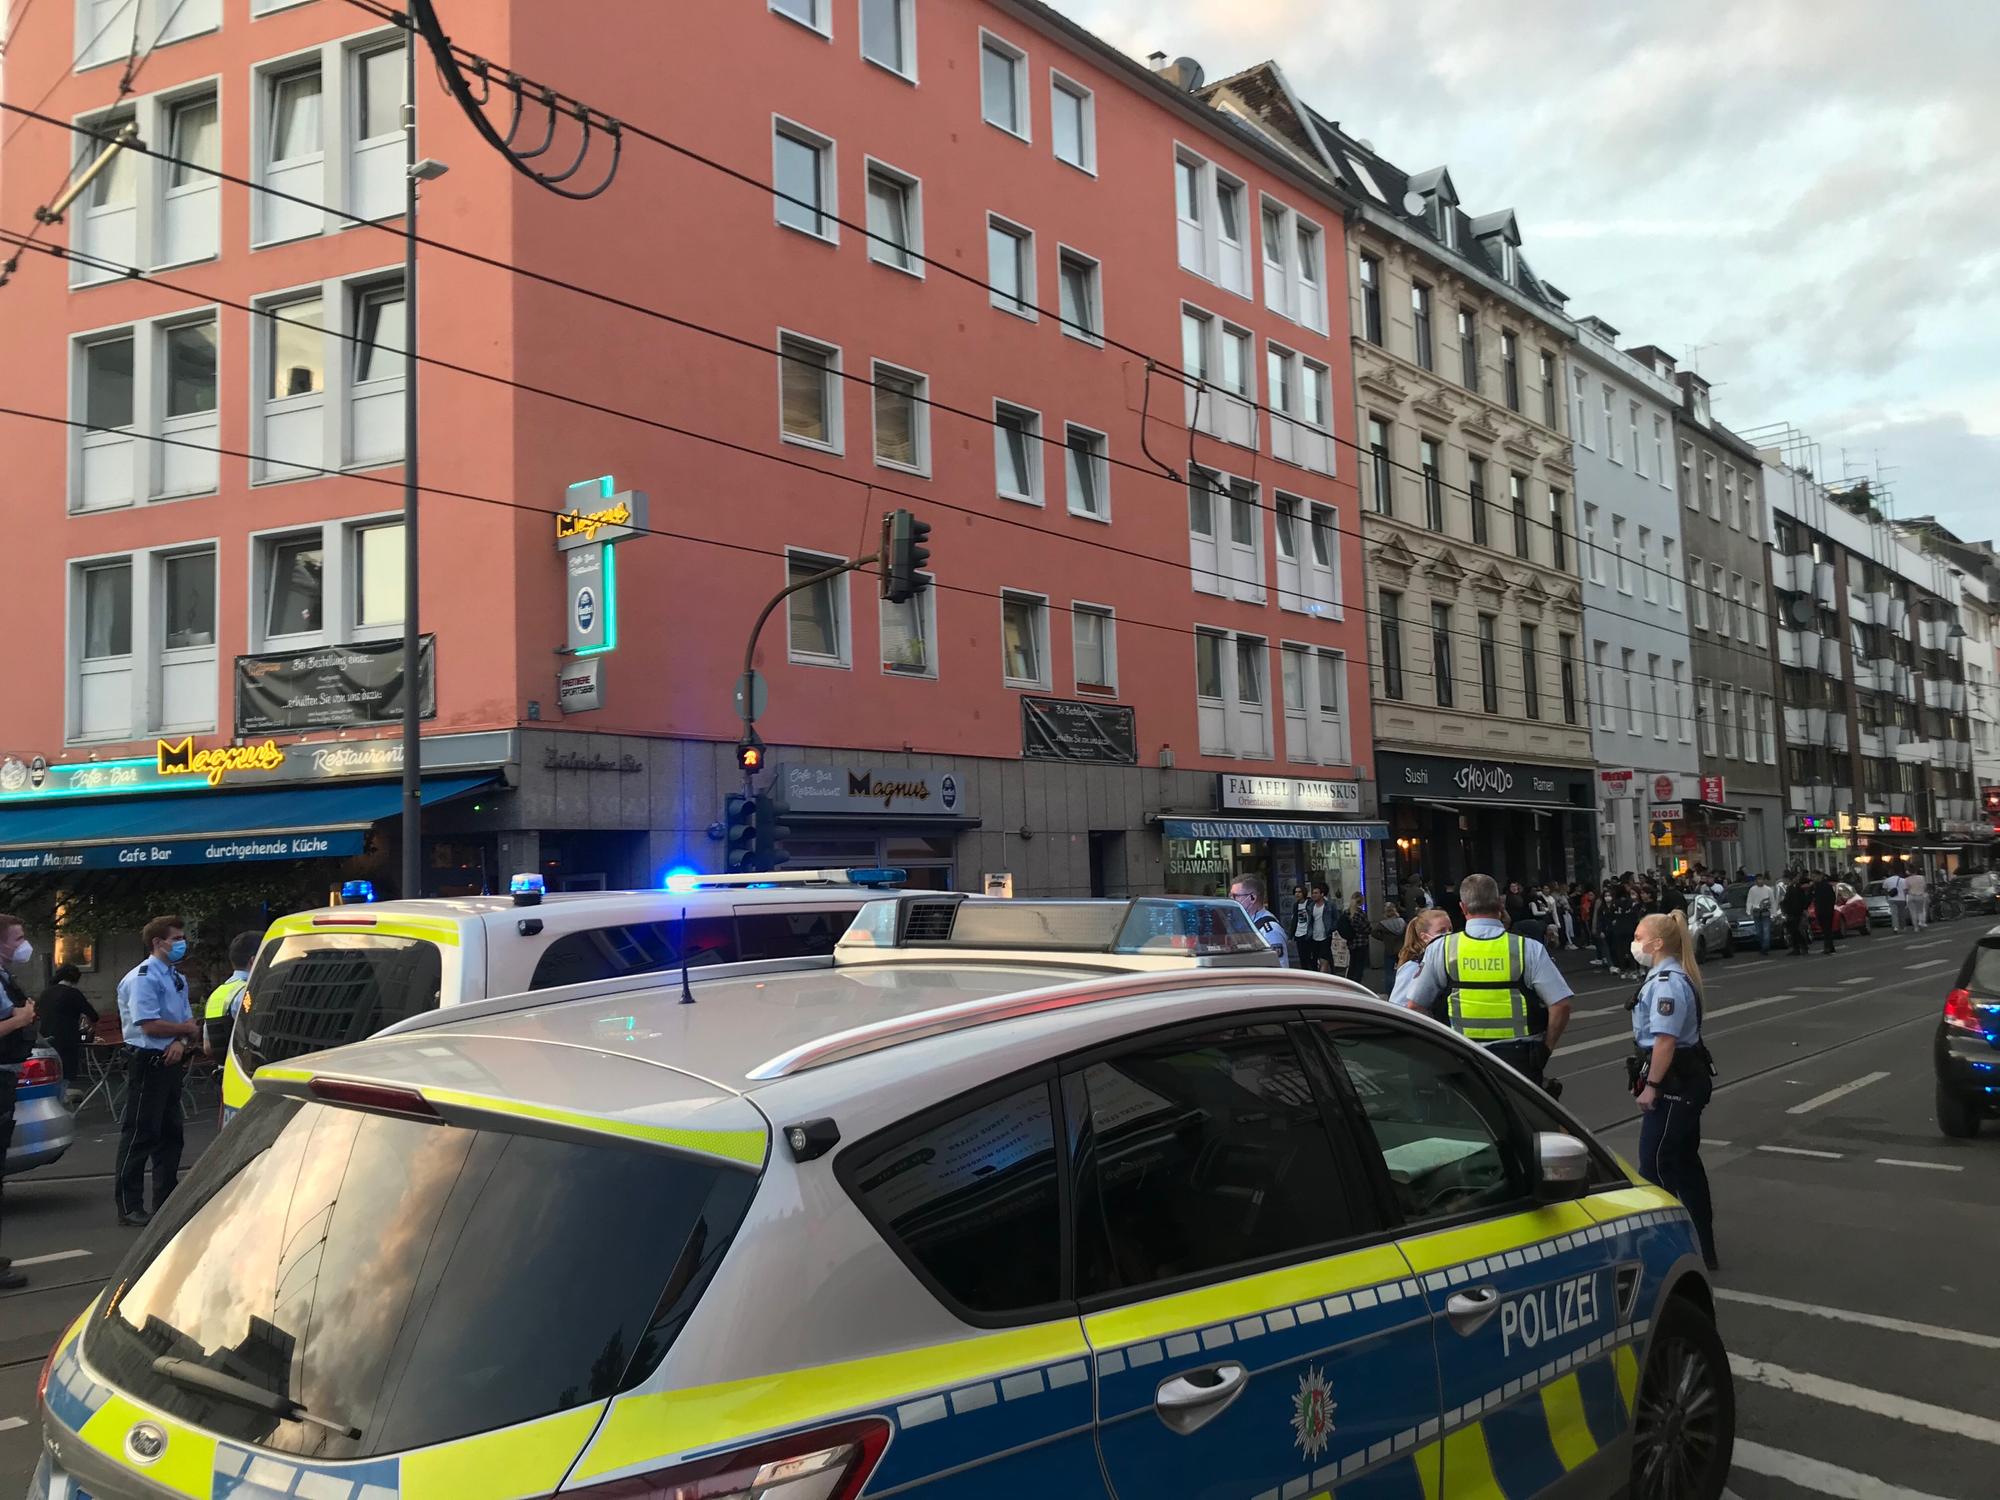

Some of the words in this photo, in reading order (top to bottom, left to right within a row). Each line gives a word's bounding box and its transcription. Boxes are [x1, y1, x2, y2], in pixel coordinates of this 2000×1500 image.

[156, 736, 285, 787] Magnus
[311, 745, 404, 772] Restaurant
[848, 768, 930, 808] Magnus
[1230, 778, 1289, 796] FALAFEL
[1297, 782, 1357, 799] DAMASKUS
[1405, 768, 1428, 784] Sushi
[1533, 777, 1555, 791] Ramen
[1652, 809, 1680, 818] KIOSK
[1191, 822, 1264, 837] SHAWARMA
[1268, 824, 1313, 838] FALAFEL
[1319, 826, 1371, 838] DAMASKUS
[0, 855, 39, 868] taurant
[42, 853, 83, 869] Magnus
[118, 848, 147, 862] Cafe
[151, 846, 172, 860] Bar
[206, 840, 287, 859] durchgehende
[292, 837, 328, 853] Küche
[1169, 839, 1229, 859] FALAFEL
[1170, 859, 1229, 874] SHAWARMA
[1463, 957, 1504, 971] POLIZEI
[1501, 1272, 1599, 1358] POLIZEI
